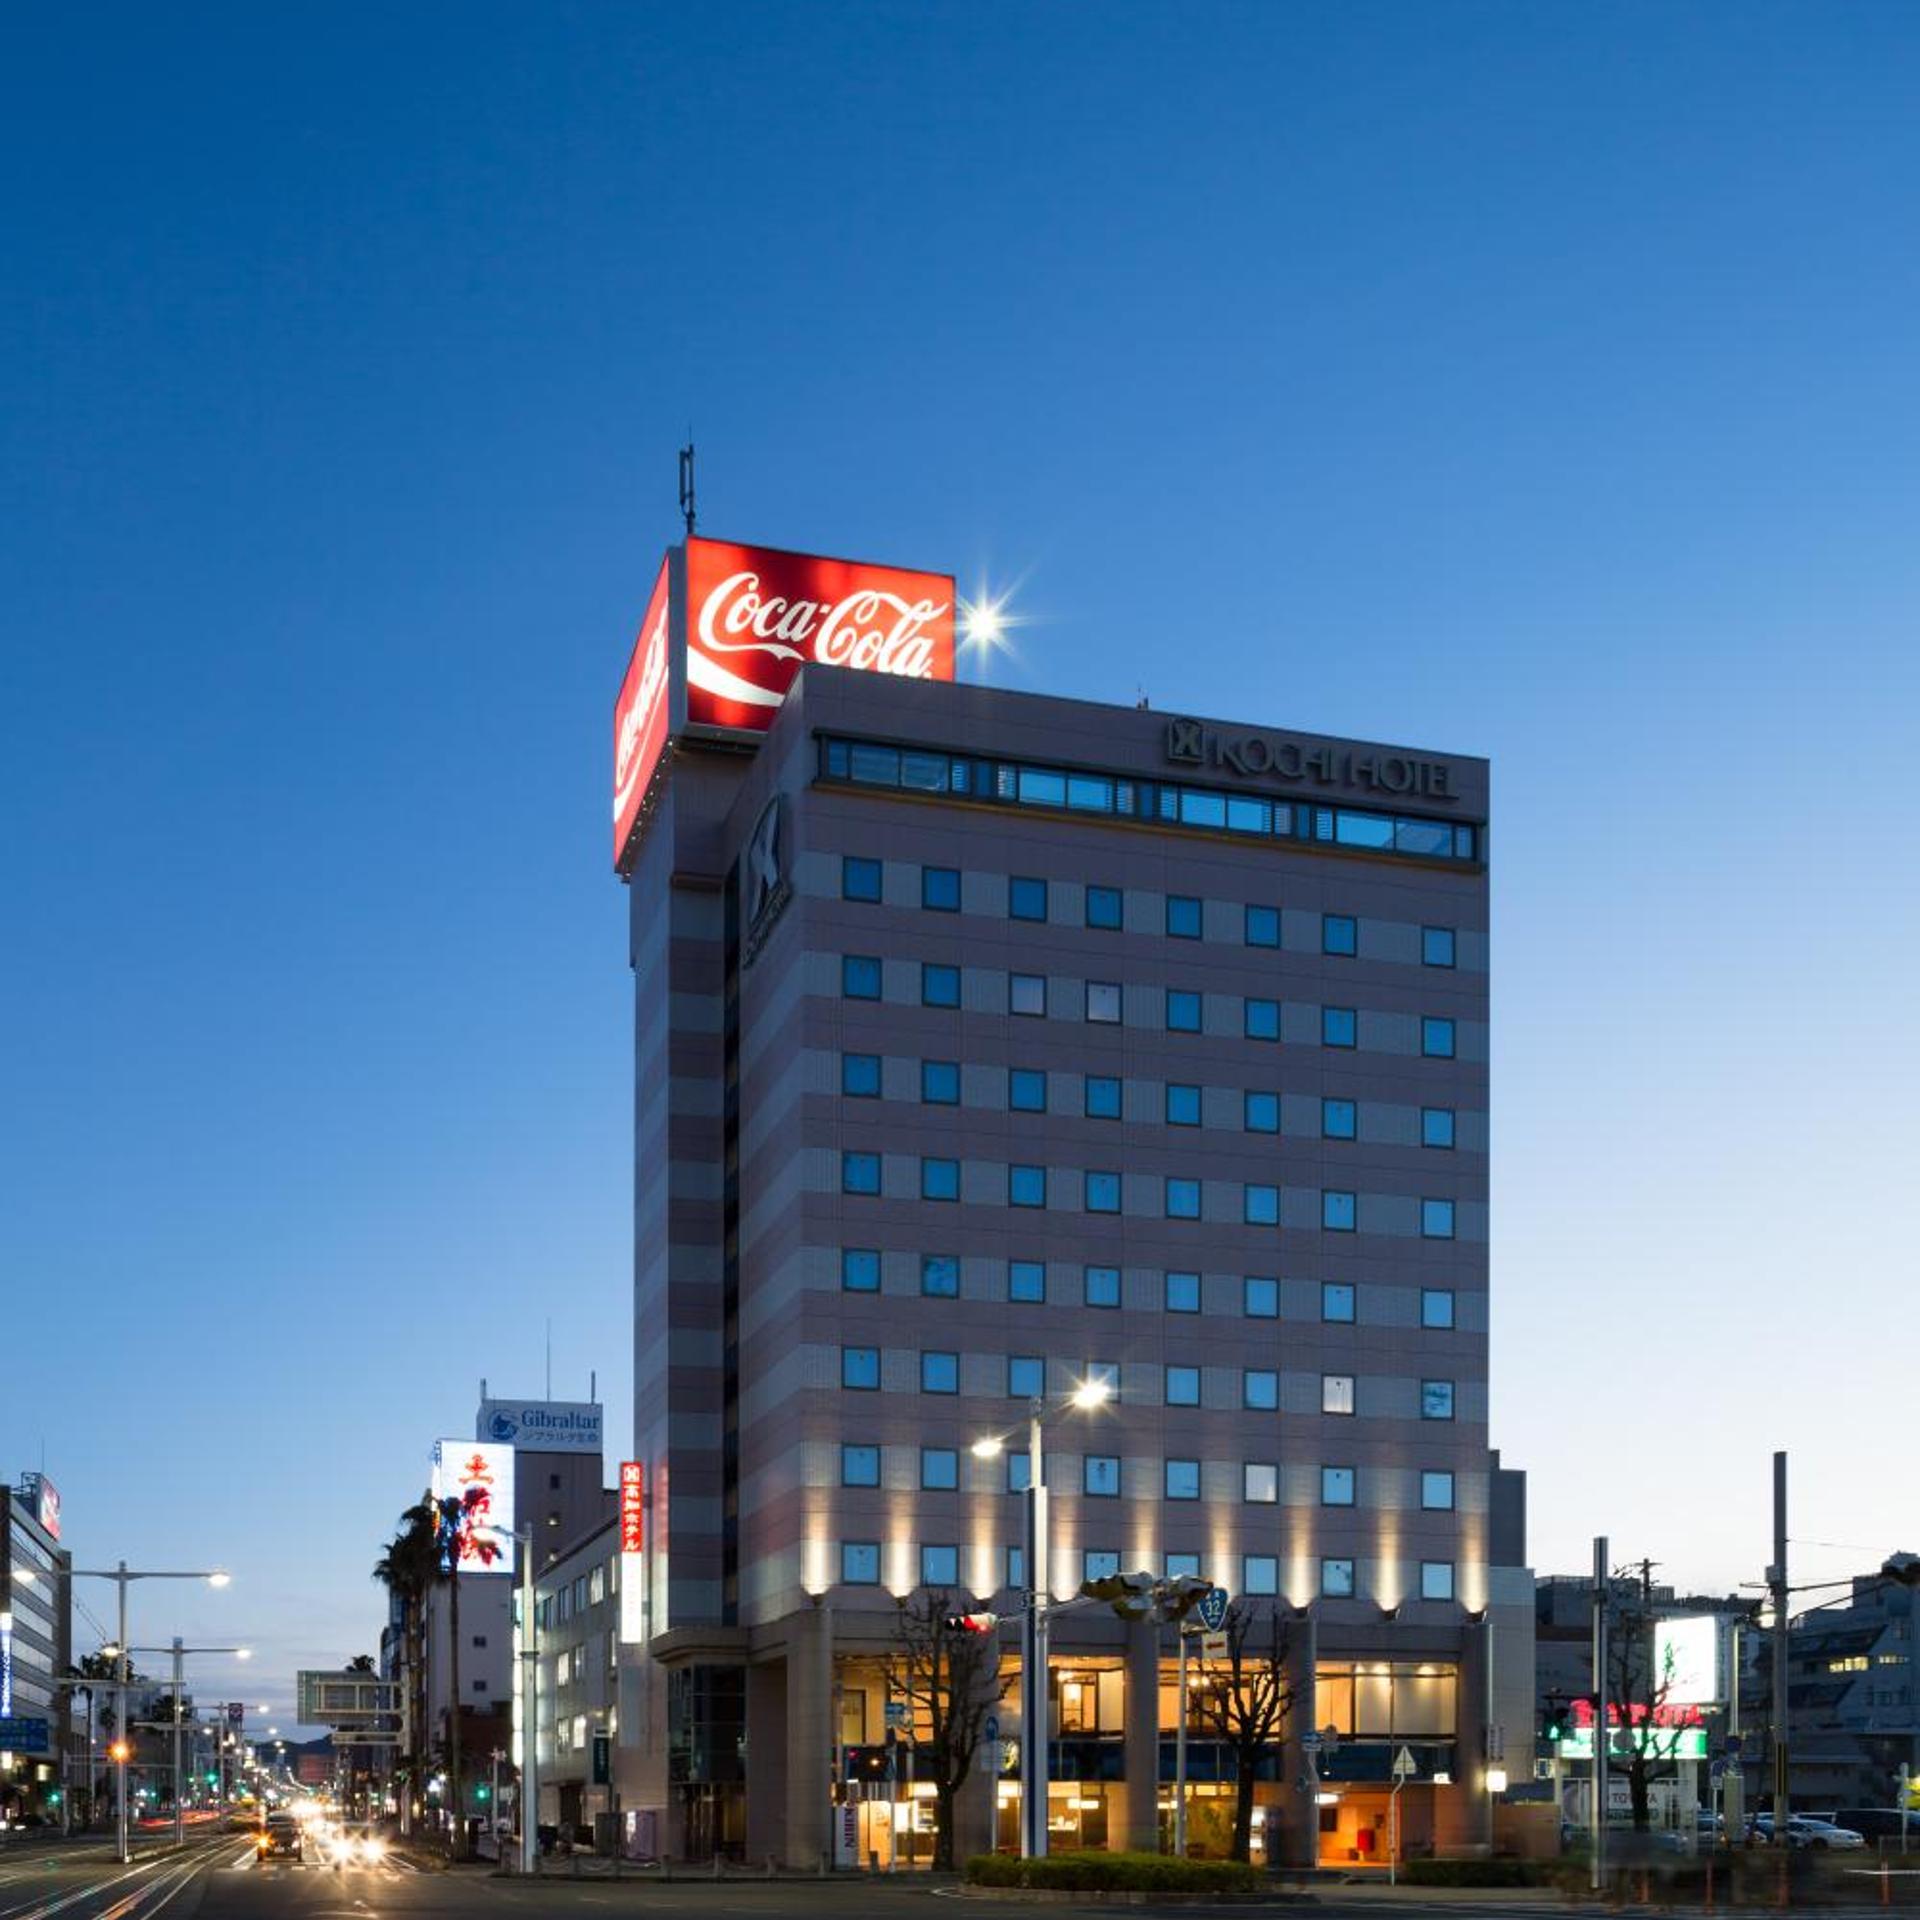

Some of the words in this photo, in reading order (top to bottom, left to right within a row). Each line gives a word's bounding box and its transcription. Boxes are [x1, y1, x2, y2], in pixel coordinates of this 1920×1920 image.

[697, 571, 949, 678] Coca-Cola
[1216, 731, 1336, 782] KOCHI
[1351, 750, 1460, 799] HOTEL
[521, 1409, 600, 1430] Gibraltar
[1206, 1599, 1222, 1617] 32
